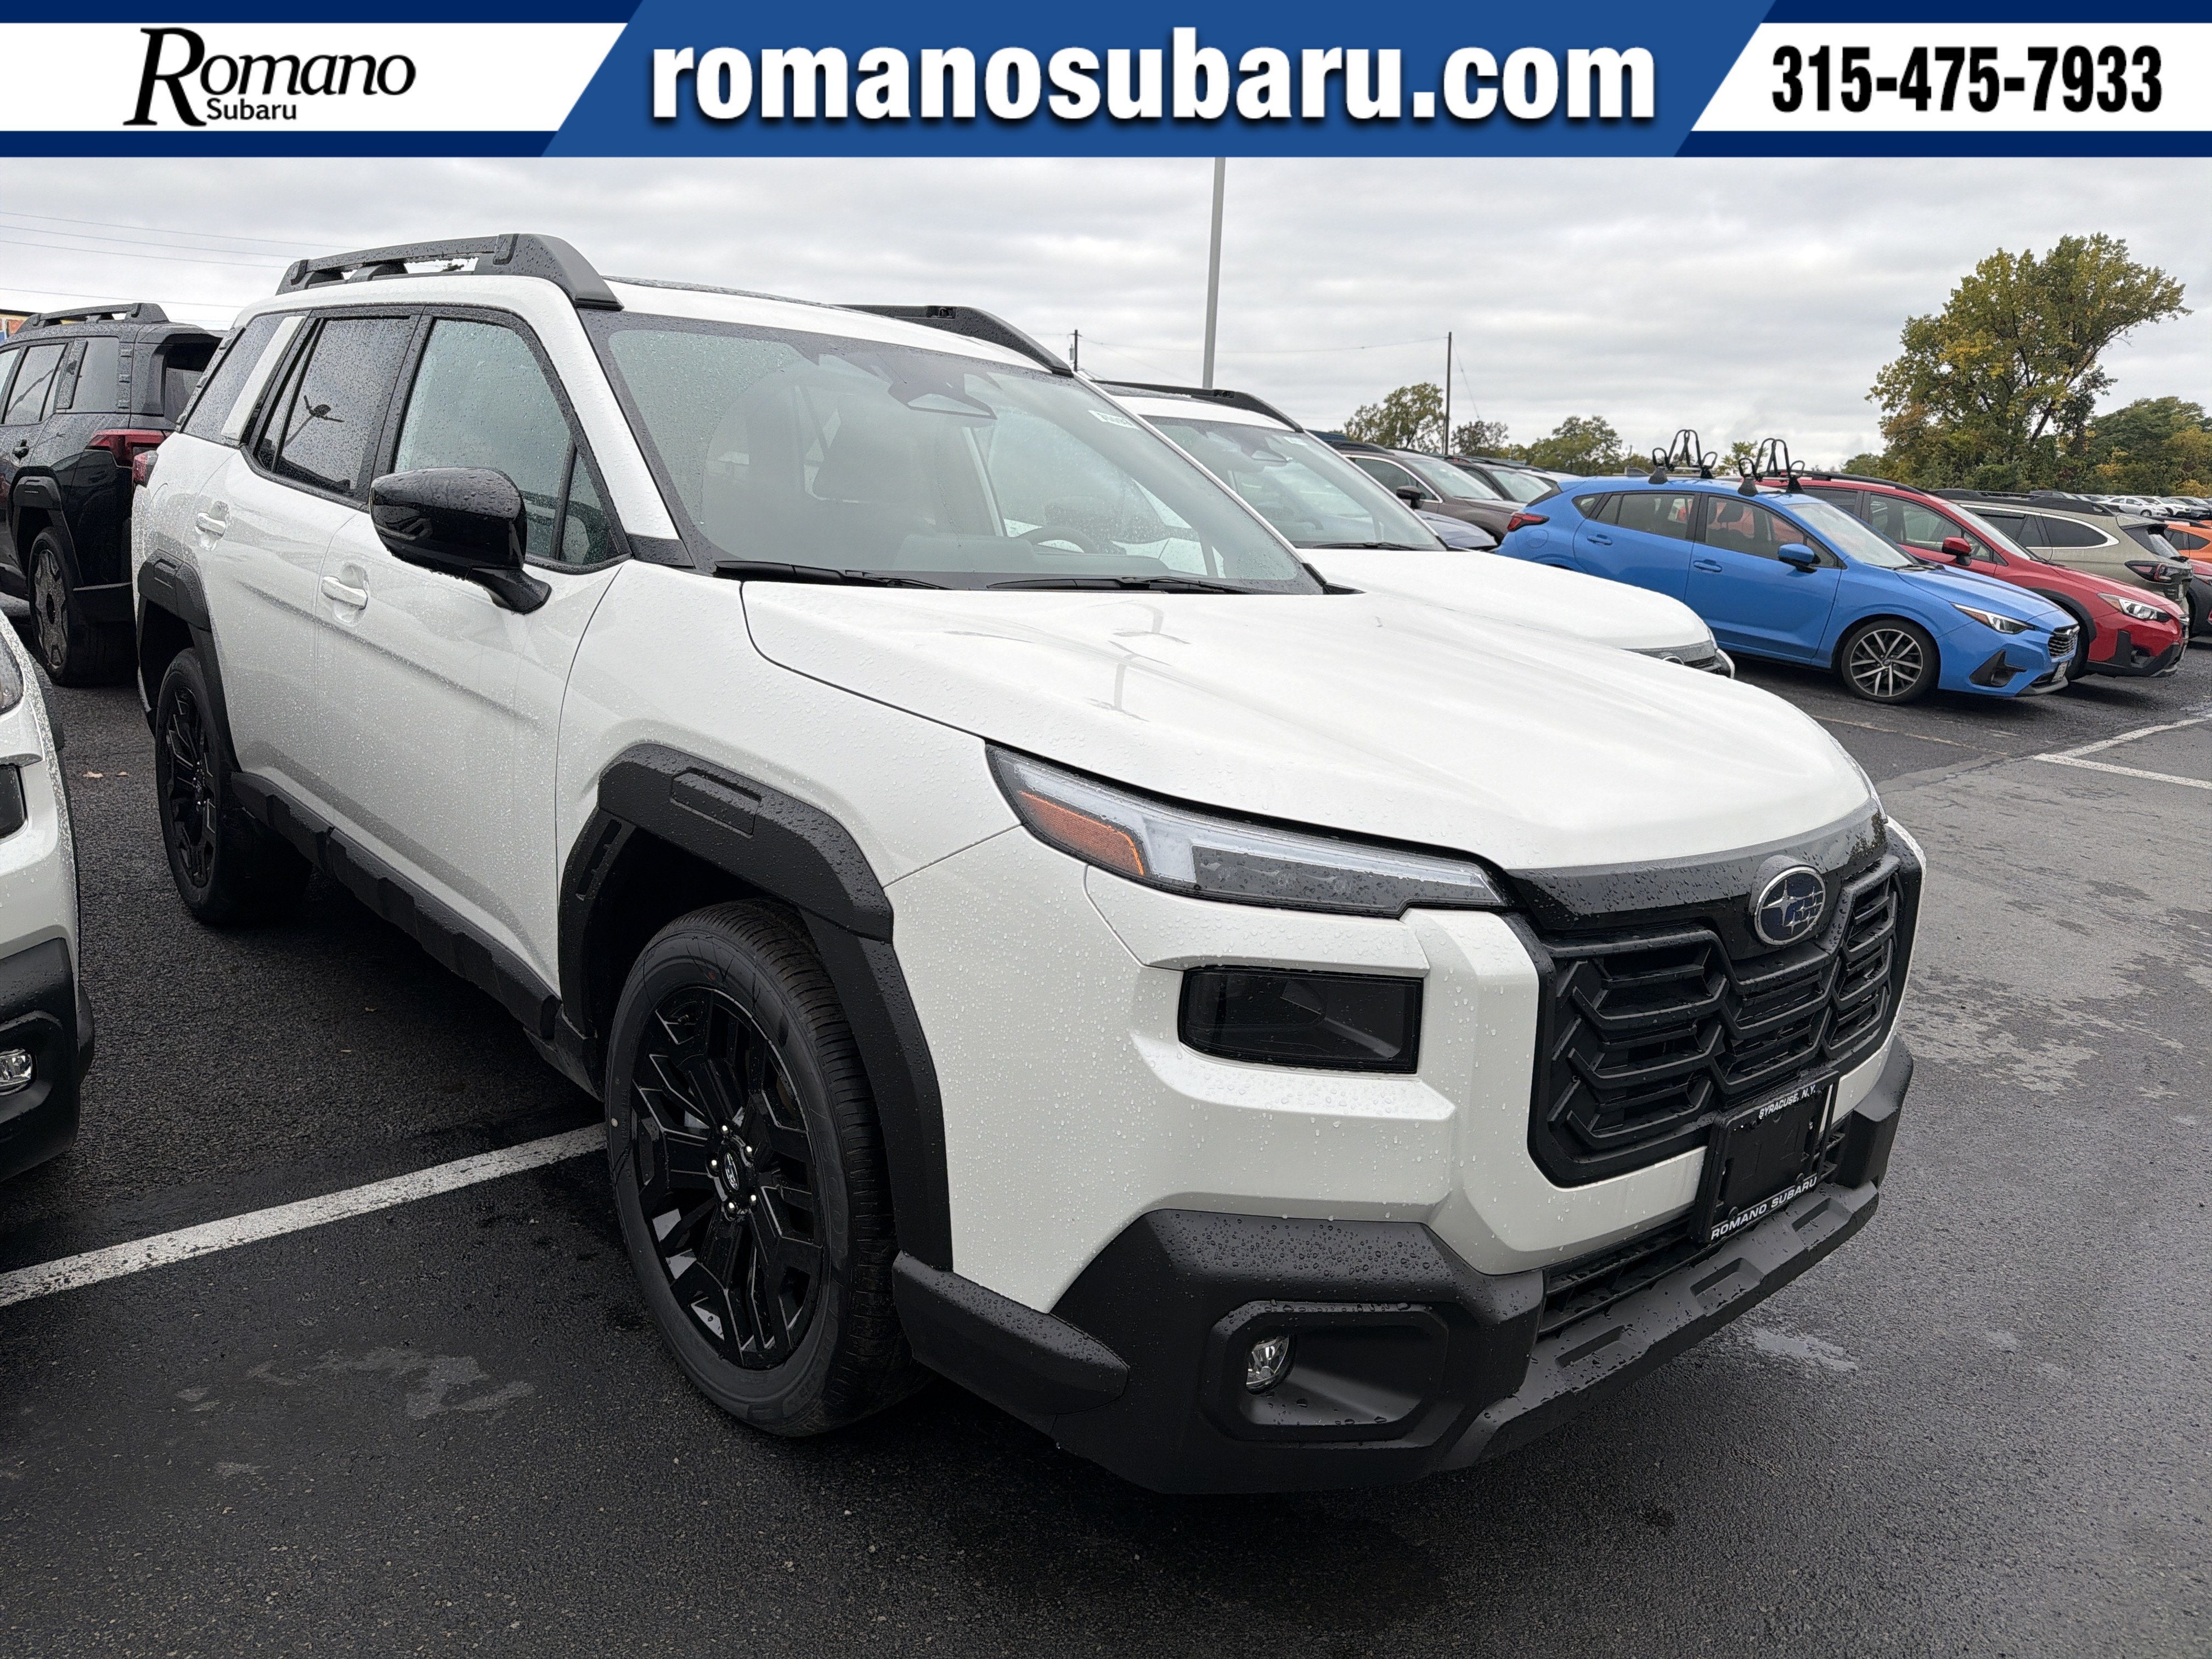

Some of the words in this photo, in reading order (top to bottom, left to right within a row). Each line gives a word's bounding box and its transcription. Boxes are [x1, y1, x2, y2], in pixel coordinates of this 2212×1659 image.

[1801, 1084, 1816, 1099] N.Y.
[1711, 1204, 1767, 1240] ROMANO
[1771, 1176, 1818, 1208] SUBARU
